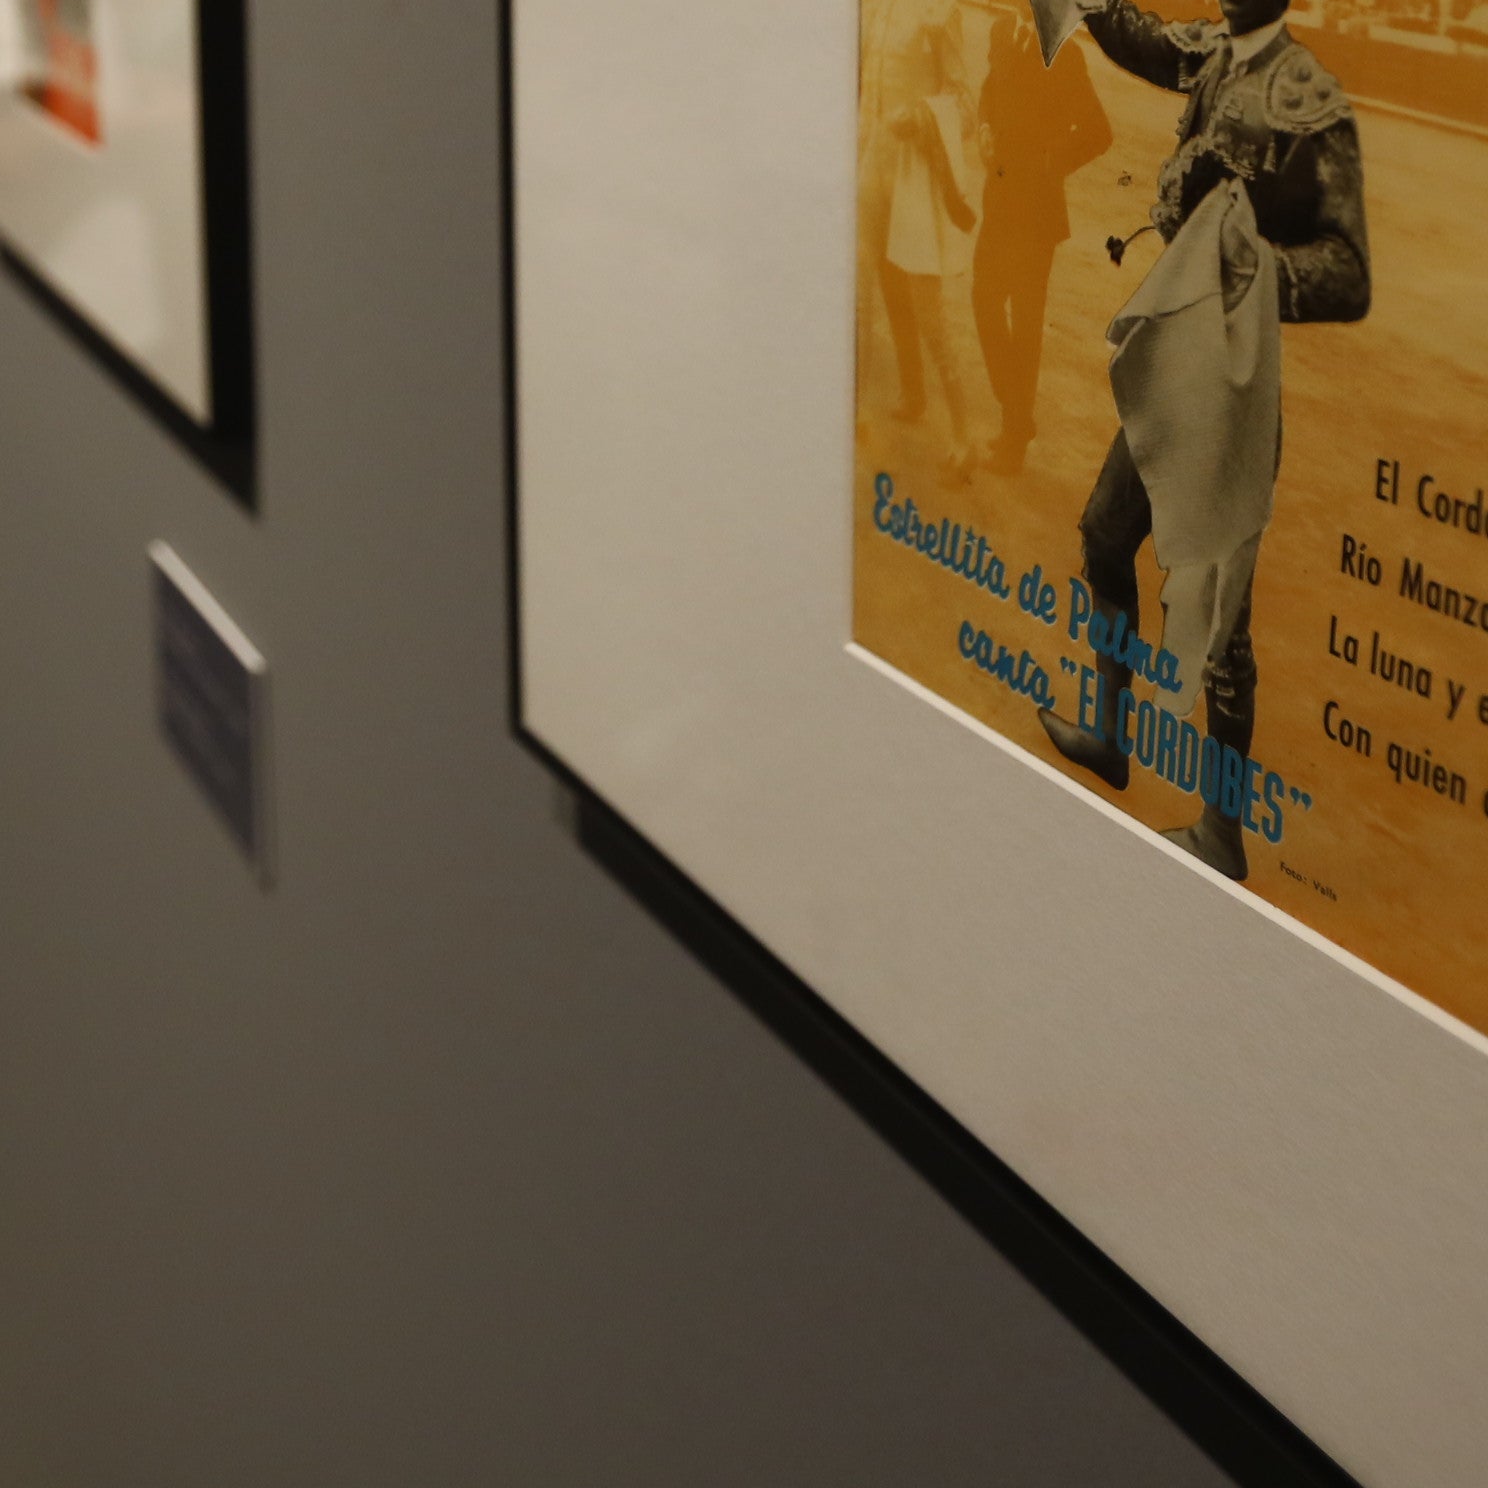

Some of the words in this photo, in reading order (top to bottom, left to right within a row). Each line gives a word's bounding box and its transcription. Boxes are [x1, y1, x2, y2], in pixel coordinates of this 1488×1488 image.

[1374, 457, 1400, 505] El
[873, 471, 1011, 599] Estrellita
[1017, 564, 1057, 625] de
[1067, 576, 1183, 694] Palma
[1340, 533, 1382, 586] Río
[958, 620, 1055, 710] canta
[1328, 614, 1358, 666] La
[1370, 631, 1432, 699] luna
[1447, 679, 1466, 721] y
[1323, 701, 1371, 757] Con
[1387, 740, 1466, 806] quien
